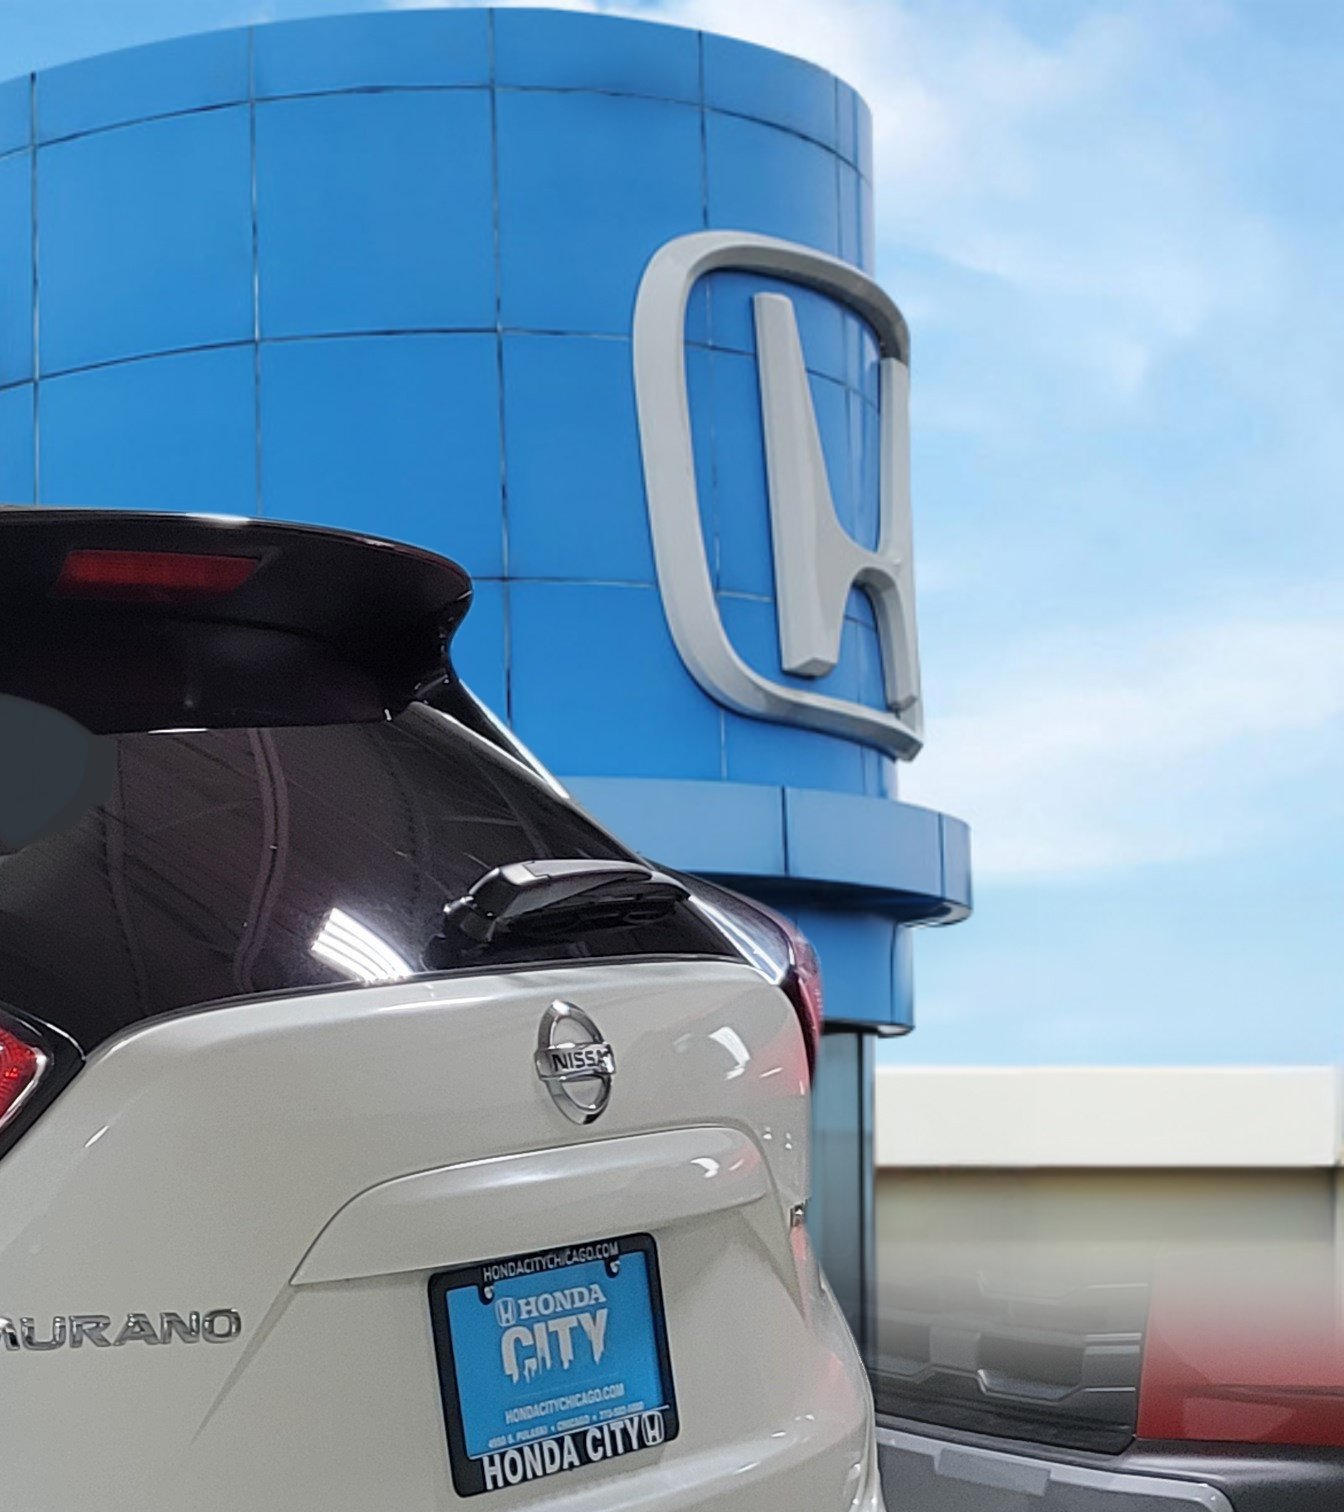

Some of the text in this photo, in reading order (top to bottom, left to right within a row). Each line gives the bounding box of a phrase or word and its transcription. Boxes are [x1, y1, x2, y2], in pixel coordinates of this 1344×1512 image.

[483, 1241, 619, 1283] HONDACITYCHICAGO.COM
[518, 1284, 607, 1320] HONDA
[500, 1307, 608, 1384] CITY
[505, 1383, 626, 1425] HONDACITYCHICAGO.COM
[482, 1412, 642, 1490] HONDA CITY
